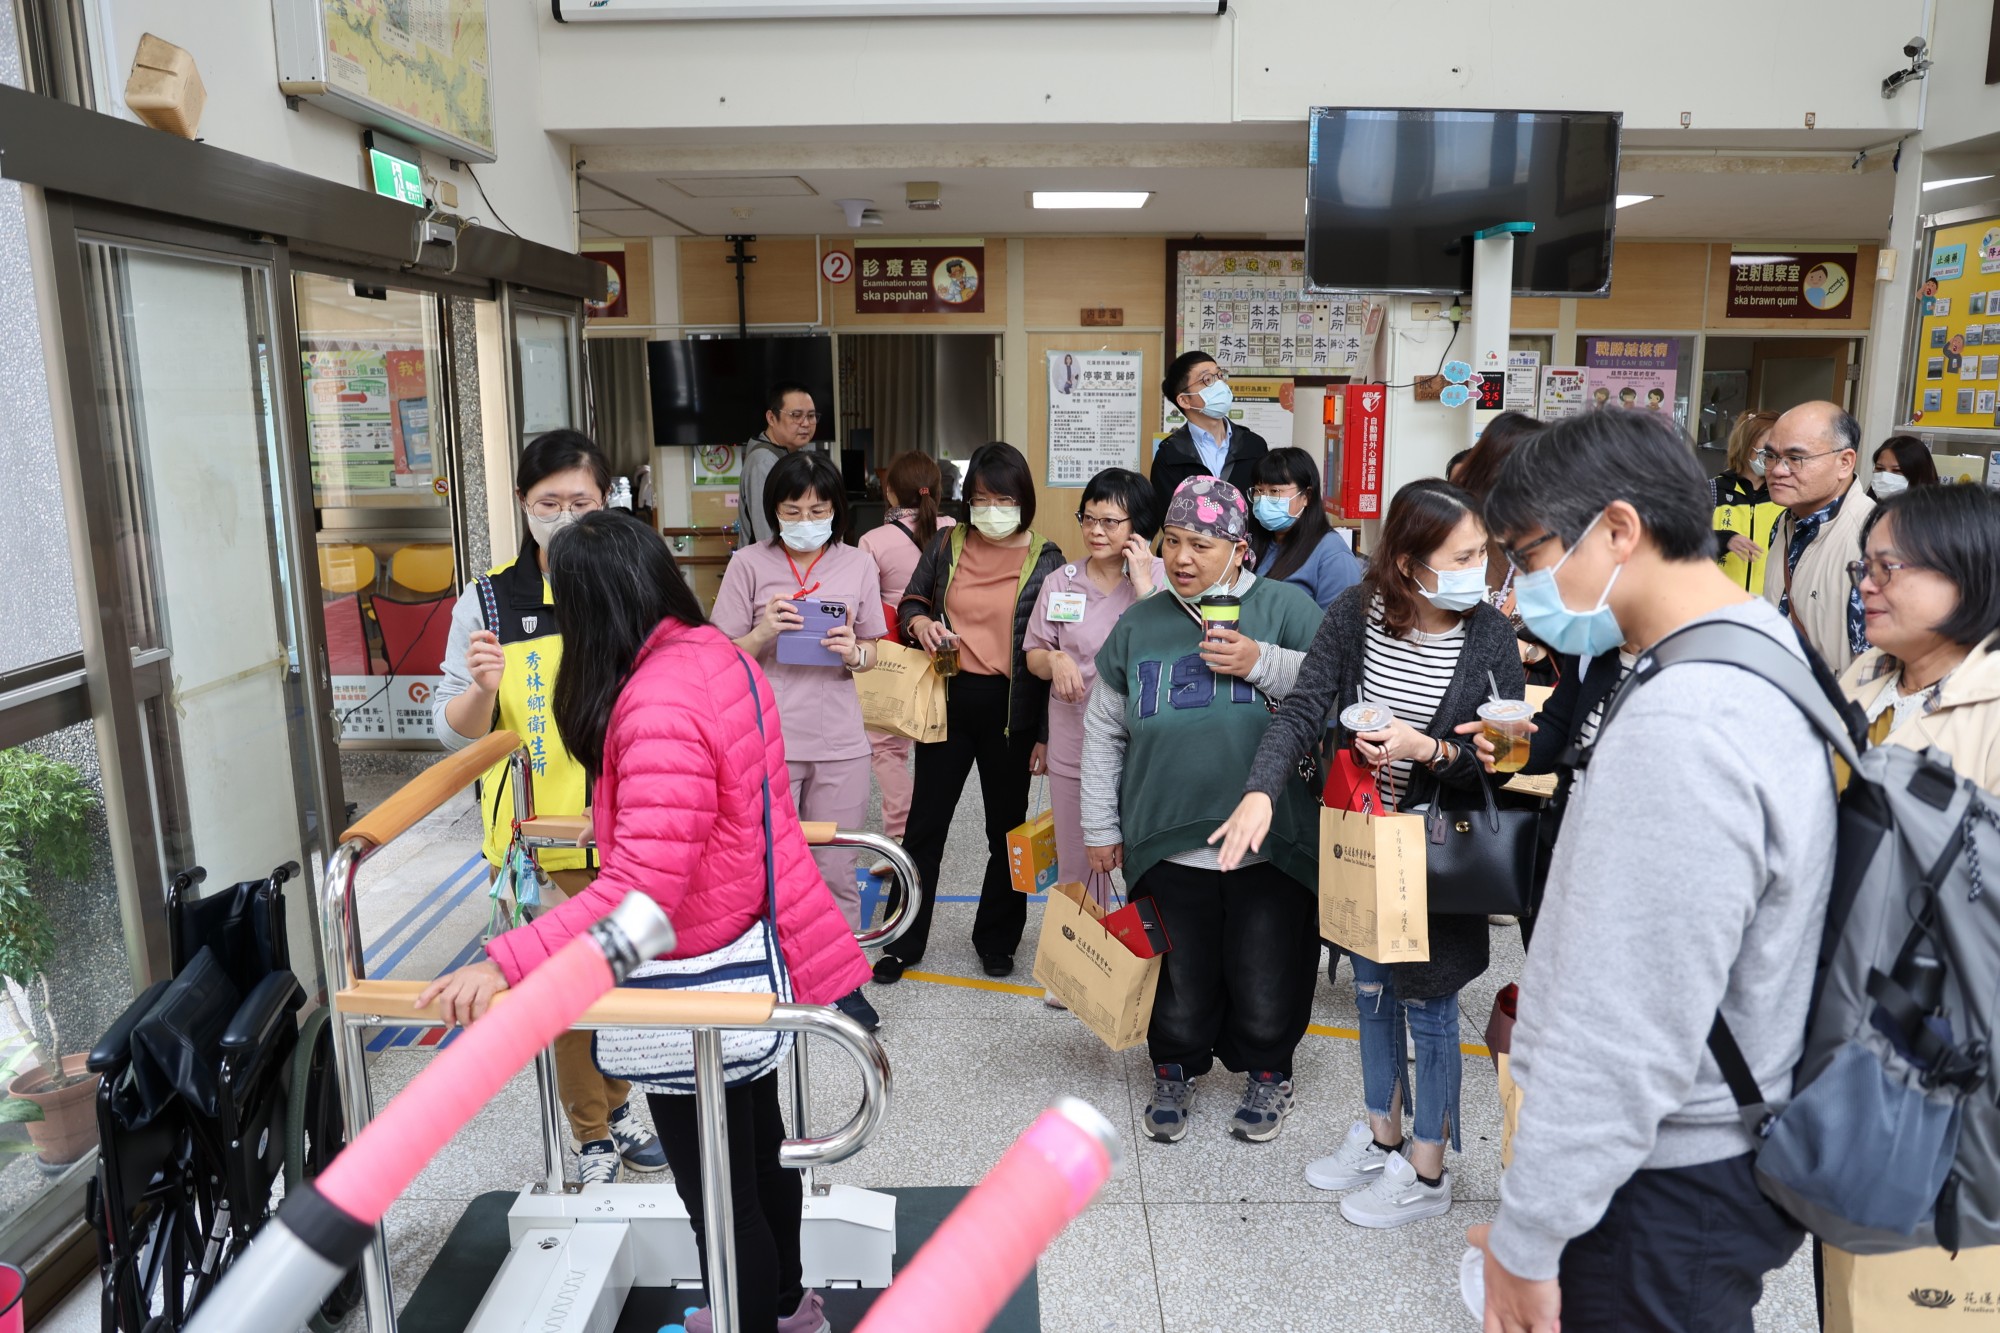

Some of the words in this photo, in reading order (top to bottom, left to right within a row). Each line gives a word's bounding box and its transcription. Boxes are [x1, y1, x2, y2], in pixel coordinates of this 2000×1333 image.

[831, 257, 844, 278] 2
[863, 259, 927, 277] 診療室
[1736, 264, 1800, 282] 注射觀察室
[863, 290, 881, 301] ska
[883, 290, 928, 303] pspuhan
[1734, 296, 1748, 305] ska
[1750, 296, 1776, 306] brawn
[1778, 296, 1798, 308] qumi
[1202, 304, 1216, 331] 本所
[1250, 304, 1264, 331] 本所
[1266, 304, 1280, 331] 本所
[1331, 305, 1344, 332] 本所
[1217, 335, 1233, 361] 本所
[1233, 338, 1247, 363] 本所
[1281, 337, 1295, 363] 本所
[1314, 337, 1327, 363] 本所
[1346, 337, 1359, 362] 本所
[1596, 341, 1668, 357] 戰勝結核病
[1116, 371, 1135, 381] 醫師
[525, 651, 547, 777] 秀林鄉衛生所
[1963, 1292, 2000, 1305] 花蓮
